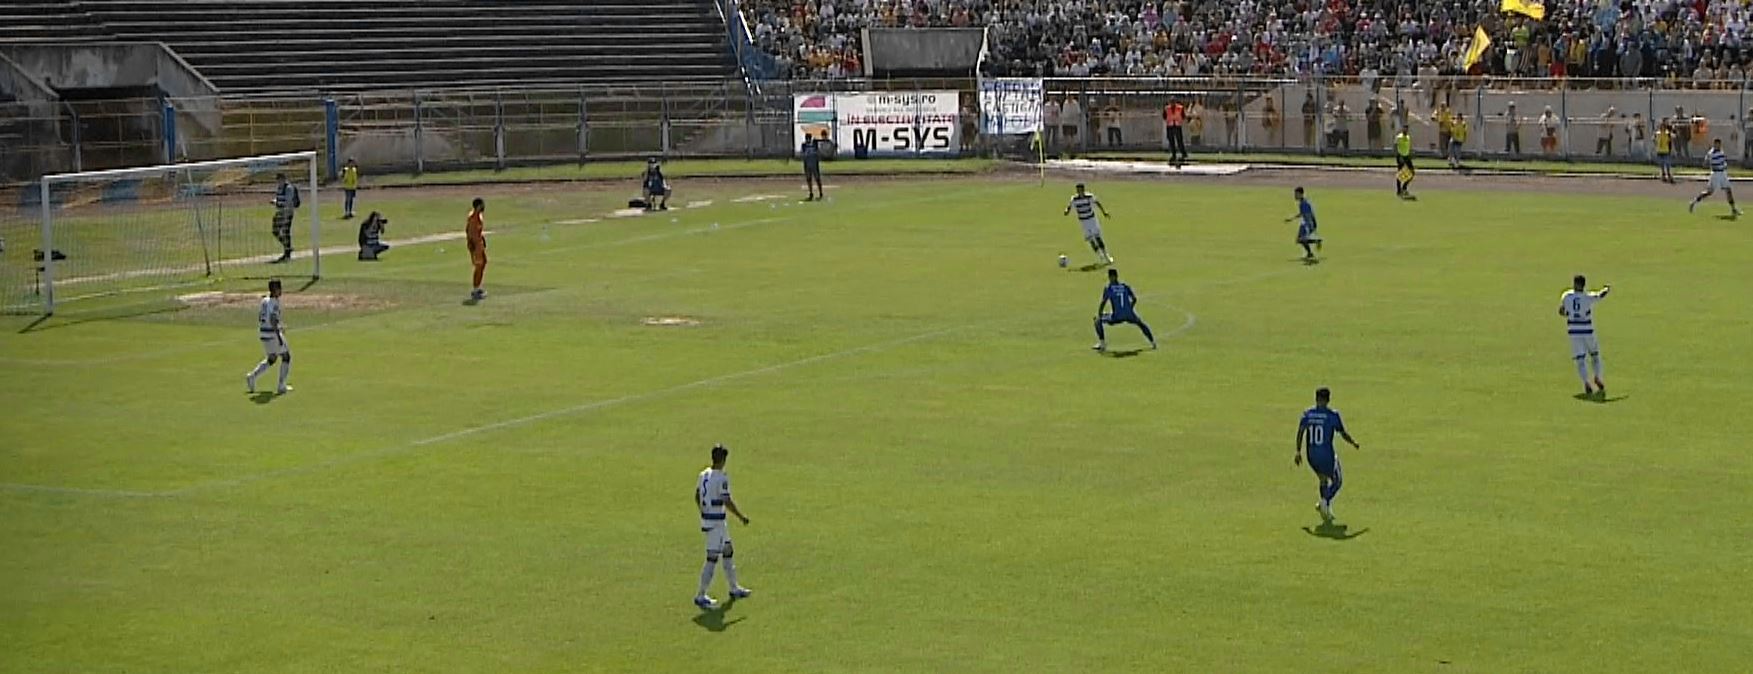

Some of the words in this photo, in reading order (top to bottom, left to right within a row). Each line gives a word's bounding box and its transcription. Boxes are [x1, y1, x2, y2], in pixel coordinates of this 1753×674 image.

[853, 127, 950, 150] M-SYS
[1572, 297, 1581, 312] 6
[1308, 425, 1324, 446] 10
